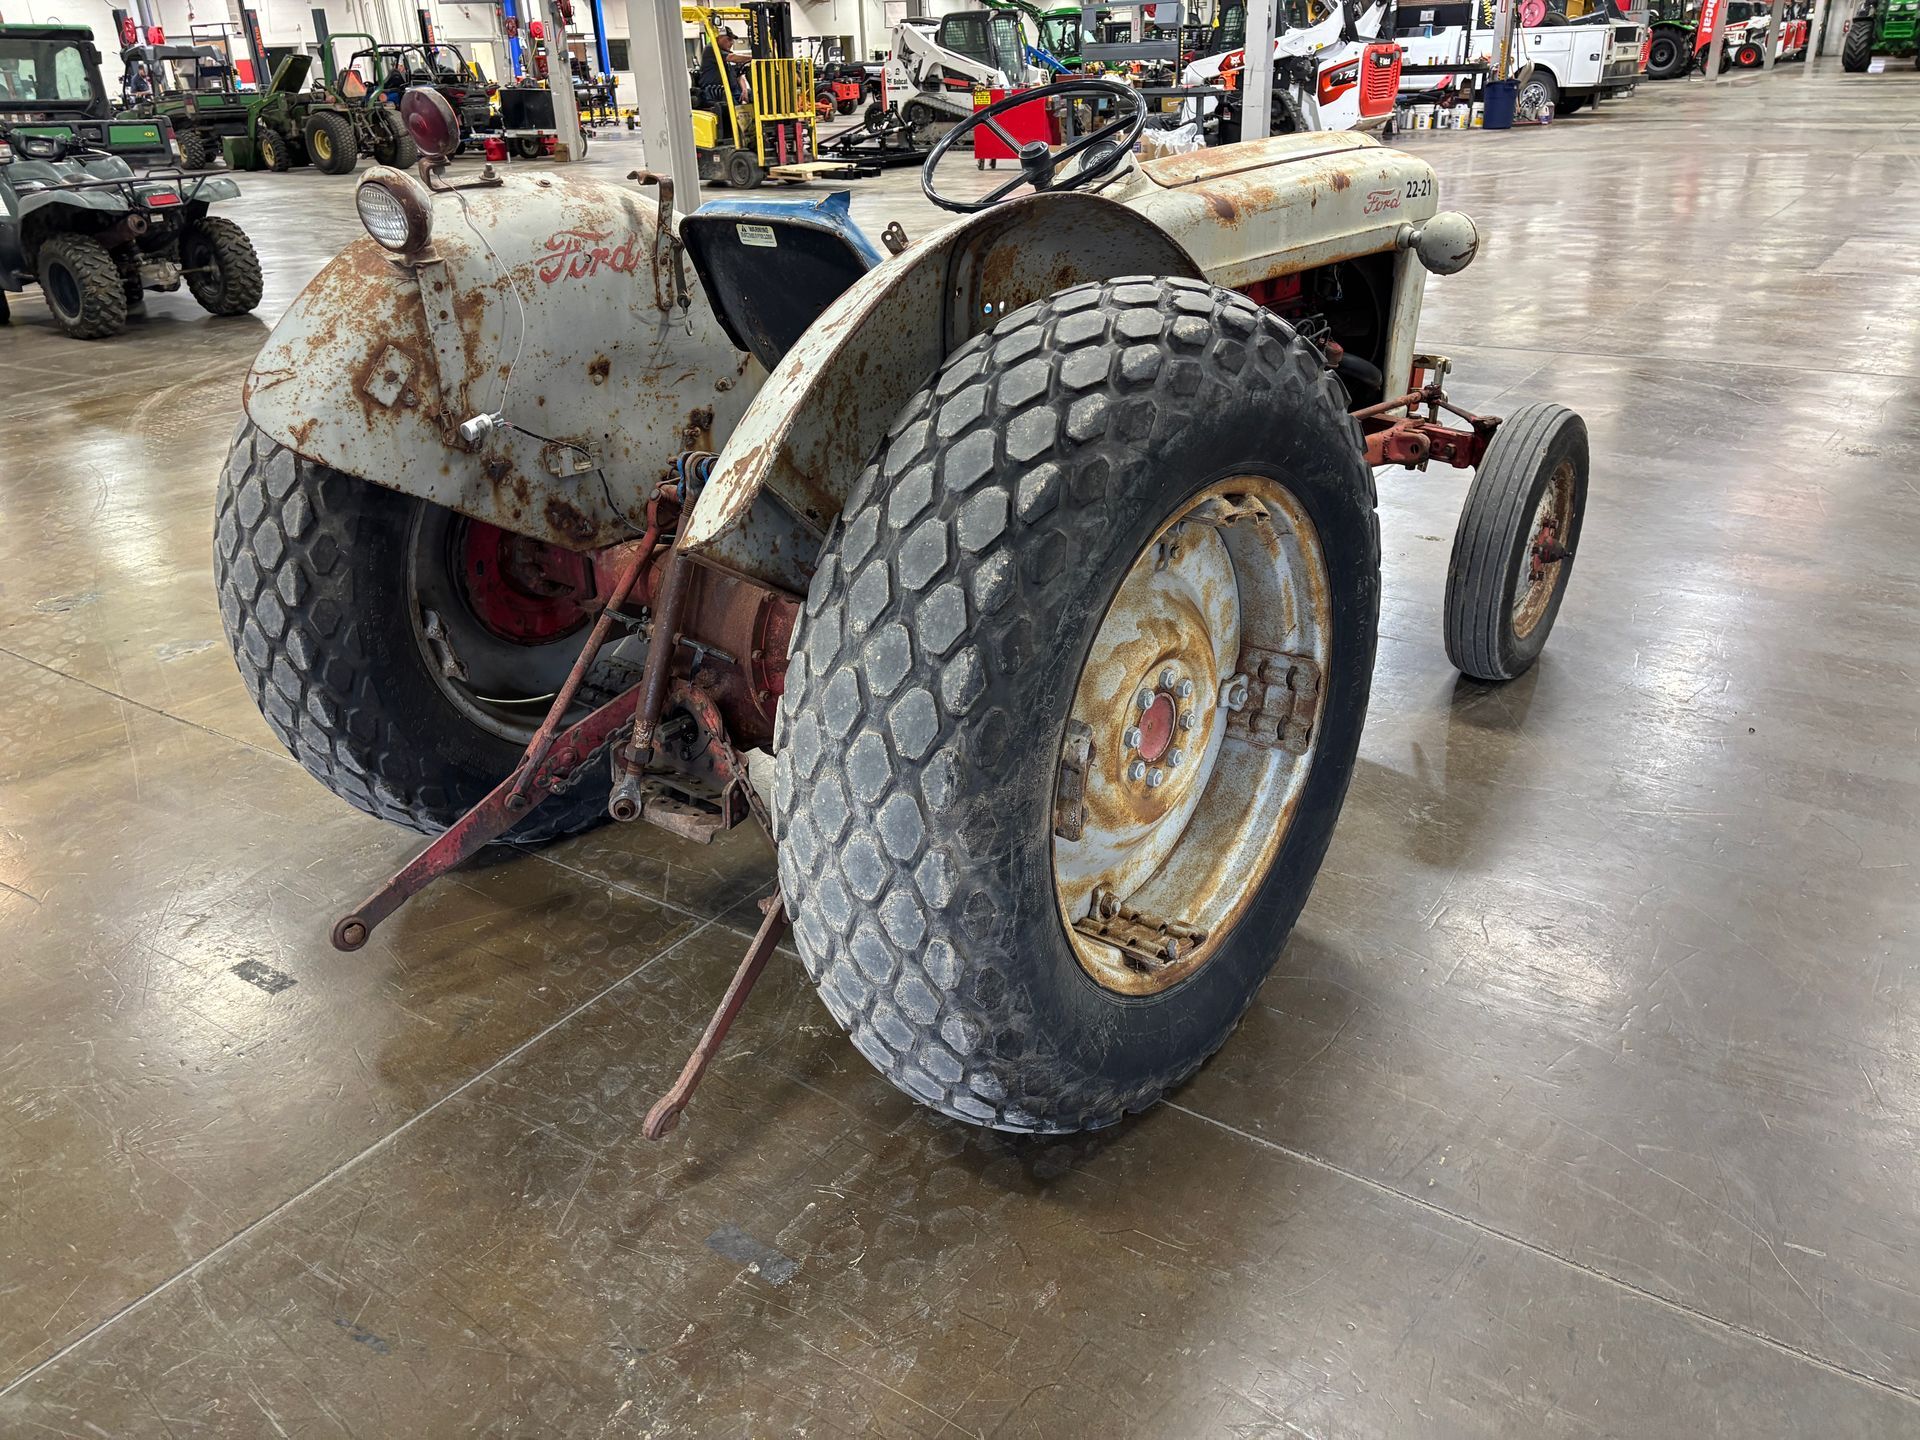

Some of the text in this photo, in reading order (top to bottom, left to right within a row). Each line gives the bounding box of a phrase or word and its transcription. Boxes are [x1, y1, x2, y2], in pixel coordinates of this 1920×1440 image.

[752, 10, 760, 45] HYSTER
[1364, 188, 1402, 214] Ford
[1406, 179, 1431, 198] 22-21
[535, 228, 641, 284] Ford
